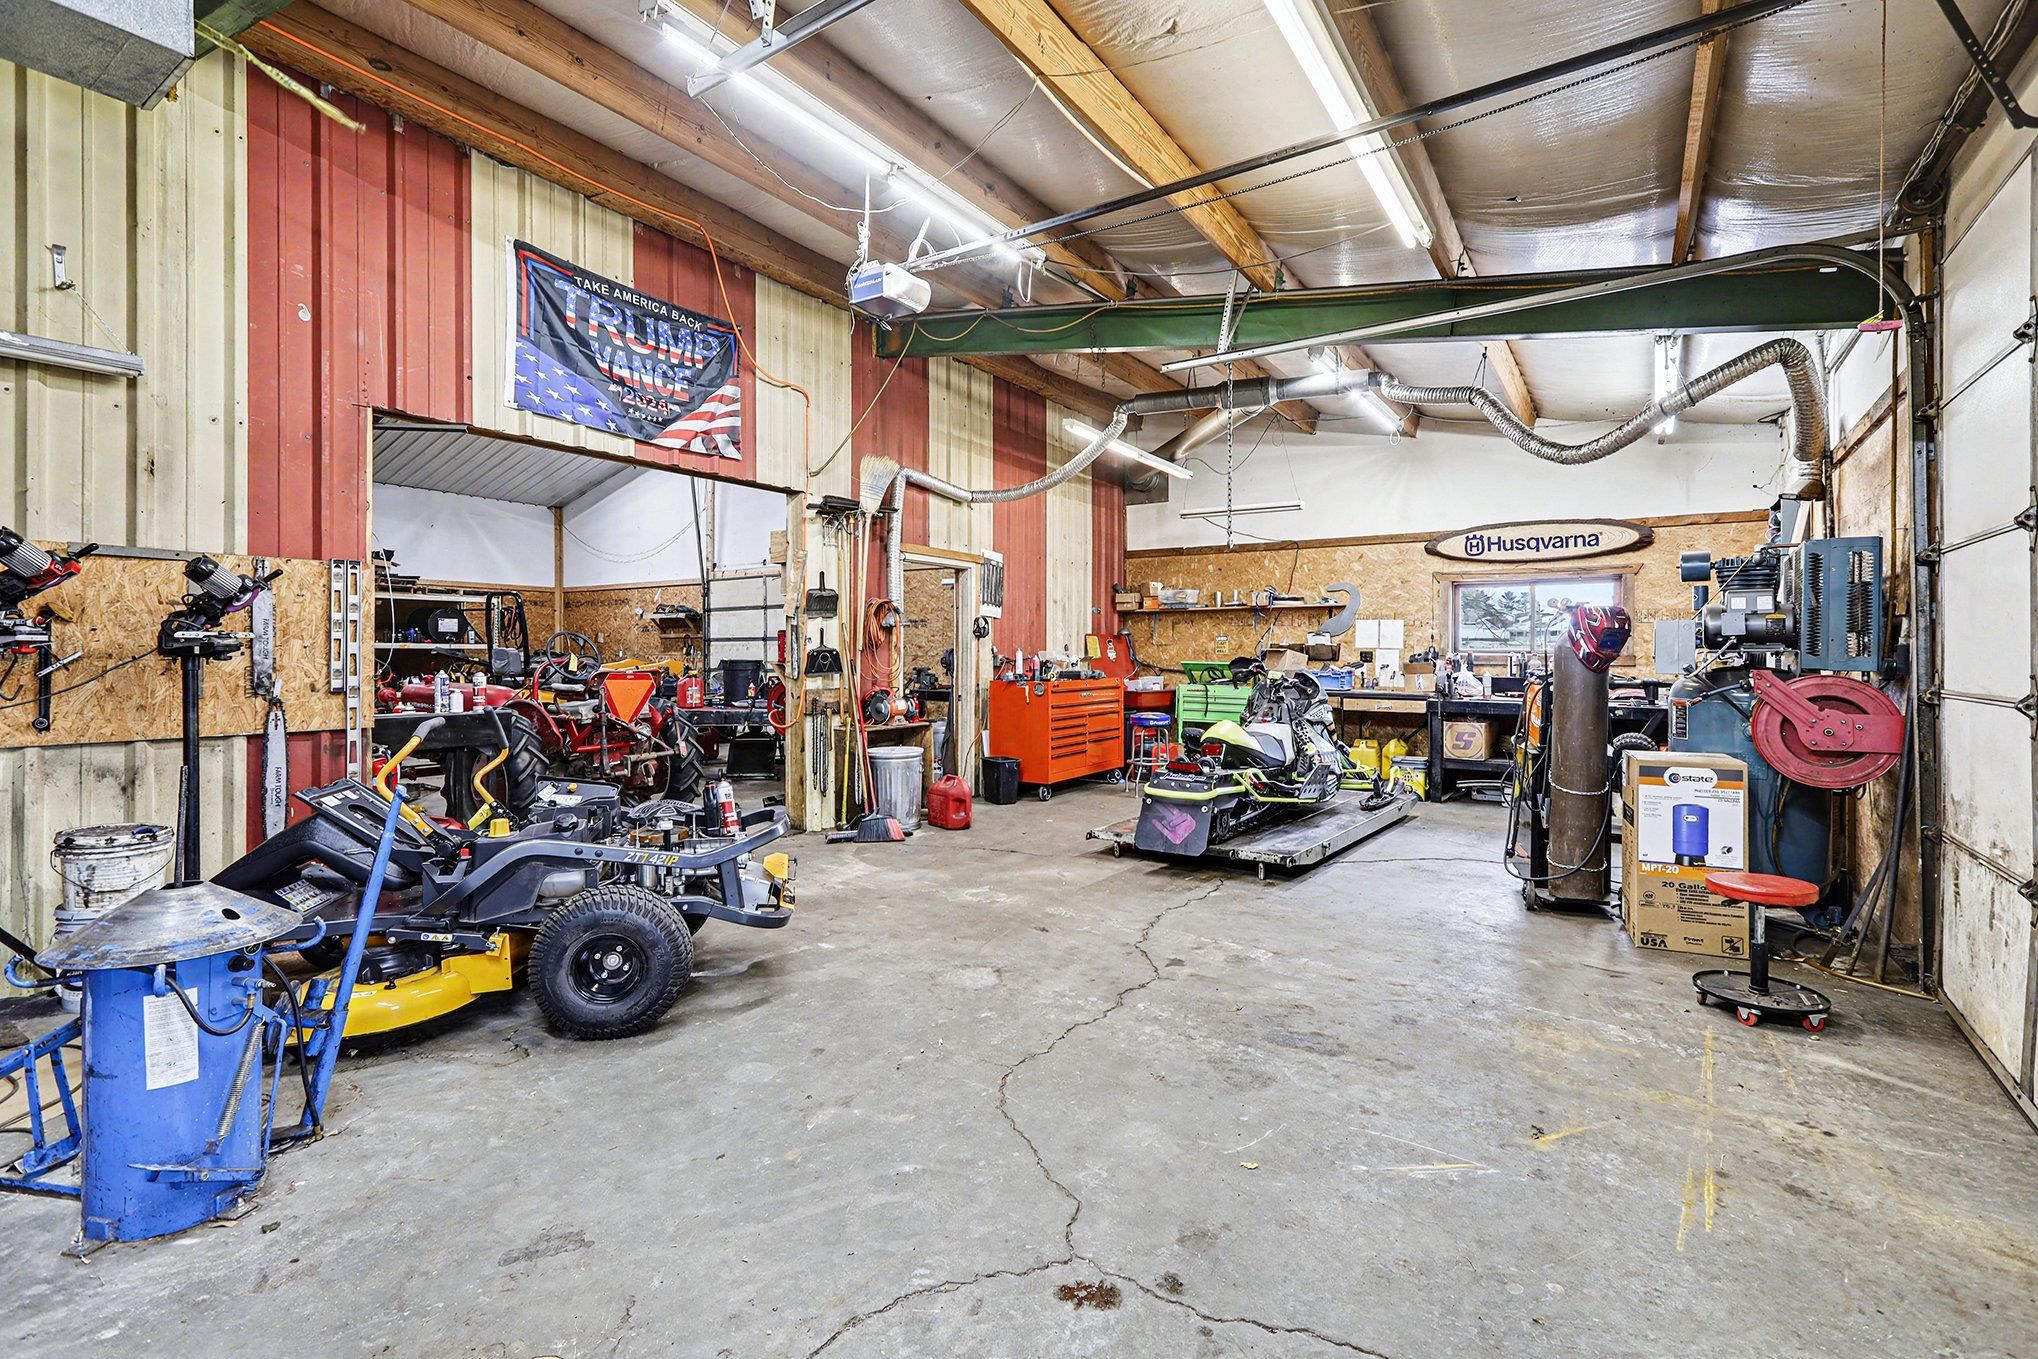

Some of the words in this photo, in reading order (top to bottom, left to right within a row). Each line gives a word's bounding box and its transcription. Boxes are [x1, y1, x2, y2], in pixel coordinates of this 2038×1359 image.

[574, 276, 610, 296] TAKE
[613, 288, 668, 317] AMERICA
[671, 310, 703, 332] BACK
[554, 278, 721, 370] TRUMP
[589, 340, 692, 402] VANCE
[623, 387, 670, 416] 2024
[1487, 533, 1600, 552] Husqvarna
[1681, 775, 1714, 783] state
[1641, 863, 1680, 874] MPT-20
[1678, 882, 1707, 891] Gallo
[1640, 936, 1668, 948] USA
